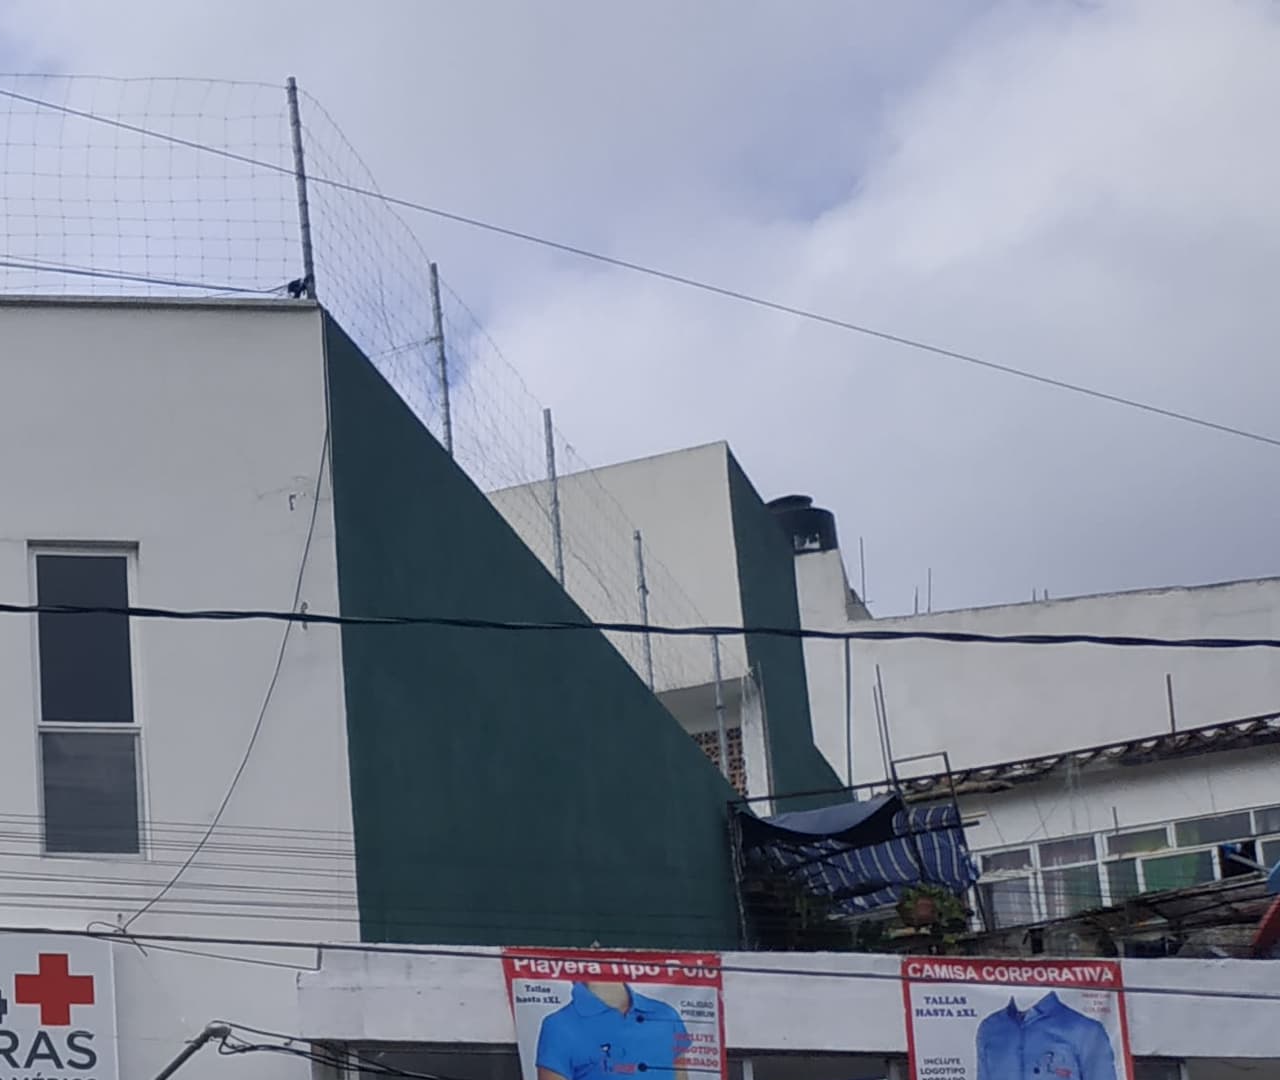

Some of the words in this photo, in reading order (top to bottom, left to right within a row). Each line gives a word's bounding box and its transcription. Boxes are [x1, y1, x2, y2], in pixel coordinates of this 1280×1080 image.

[514, 958, 600, 978] Playera
[610, 960, 660, 980] Tipo
[666, 960, 718, 979] Polo
[908, 963, 978, 981] CAMISA
[982, 965, 1114, 982] CORPORATIVA
[680, 1000, 714, 1008] CALIDAD
[924, 995, 967, 1005] TALLAS
[681, 1009, 715, 1017] PREMIUM
[915, 1008, 952, 1018] HASTA
[956, 1009, 978, 1018] 2XL
[920, 1067, 966, 1075] LOGOTIPO
